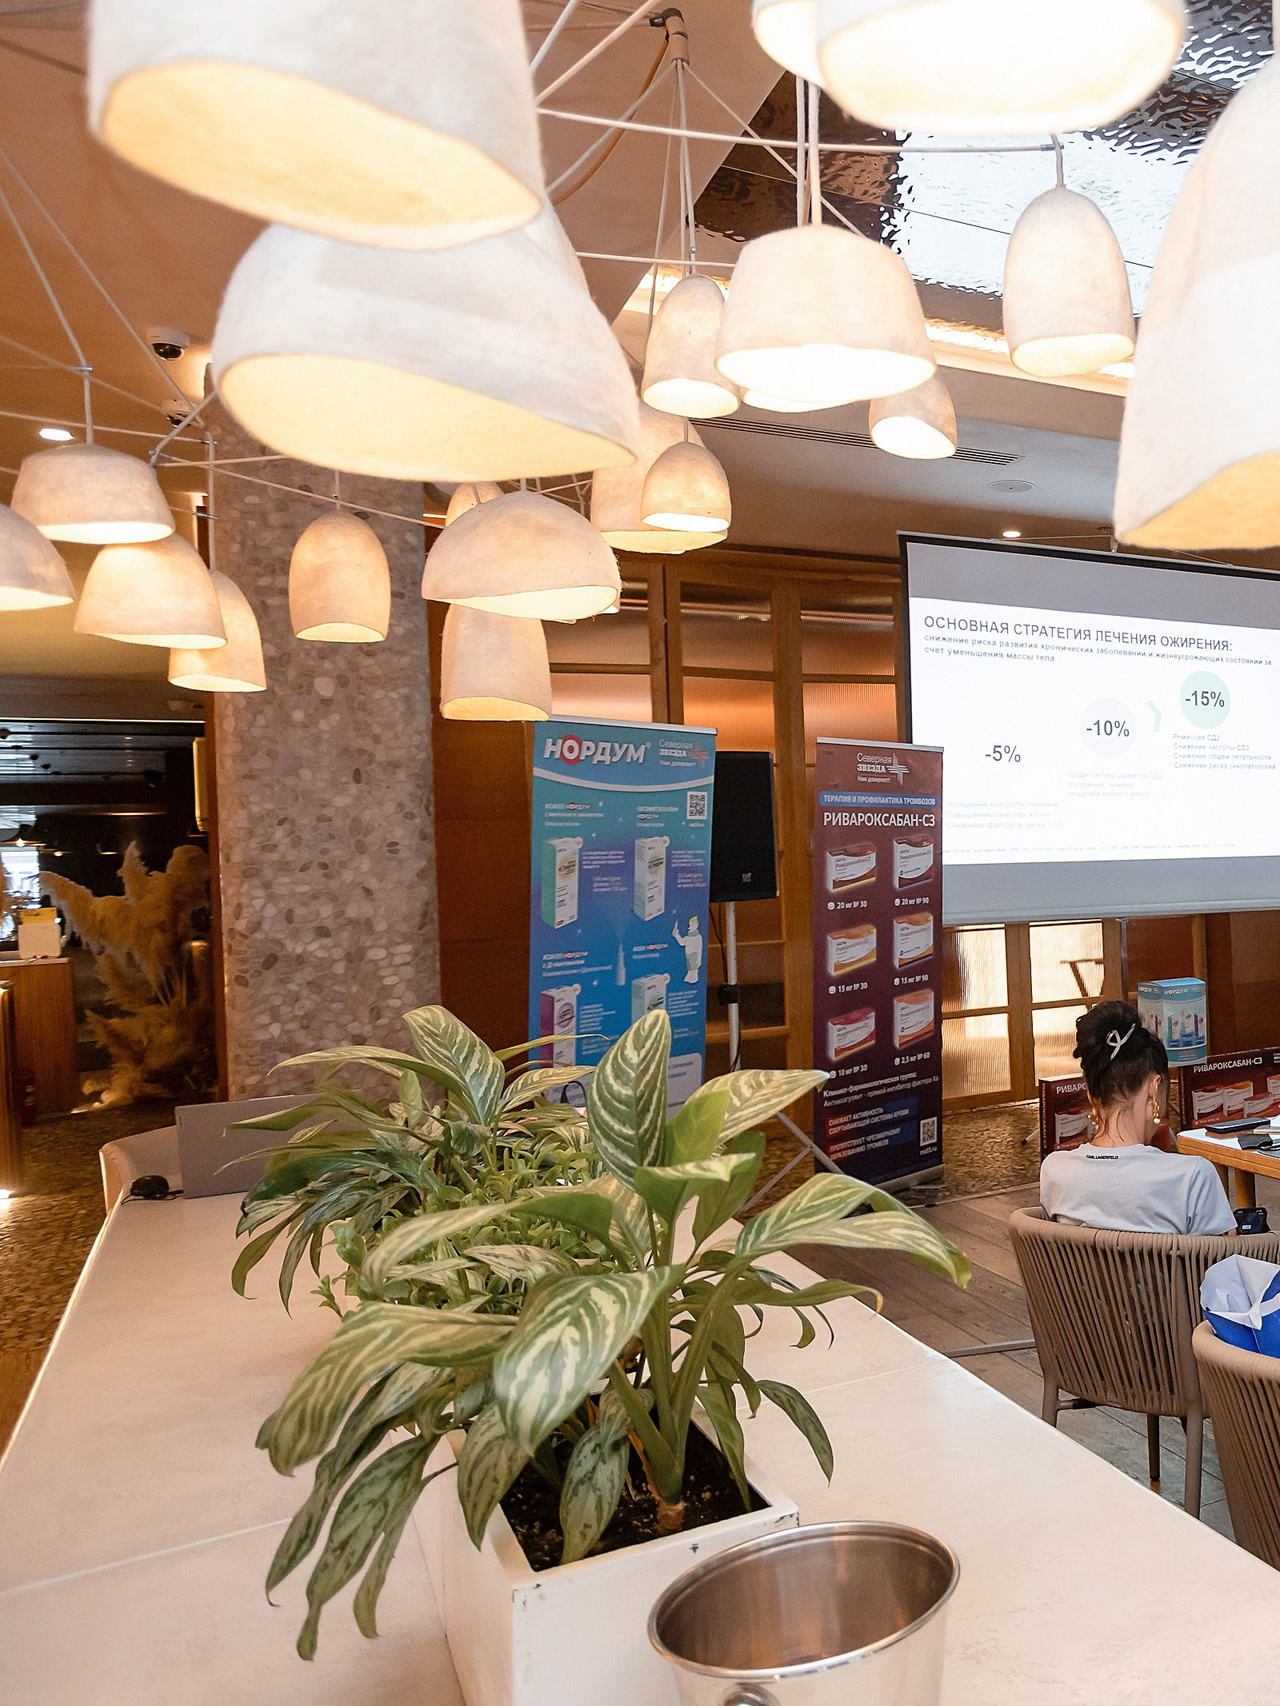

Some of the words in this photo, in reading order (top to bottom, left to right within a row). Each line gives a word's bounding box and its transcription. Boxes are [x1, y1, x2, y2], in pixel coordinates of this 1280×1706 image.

[924, 616, 1009, 634] ОСНОВНАЯ
[1013, 624, 1091, 641] СТРАТЕГИЯ
[1095, 630, 1156, 646] ЛЕЧЕНИЯ
[1160, 636, 1233, 652] ОЖИРЕНИЯ:
[924, 634, 969, 645] снижение
[971, 639, 997, 648] риска
[999, 641, 1038, 650] развития
[1041, 644, 1093, 654] хронических
[1096, 648, 1146, 657] заболеваний
[1155, 653, 1224, 662] жизнеугрожающих
[1226, 656, 1262, 665] состояний
[924, 646, 943, 654] счет
[947, 649, 1003, 659] уменьшения
[1006, 653, 1033, 661] массы
[1185, 690, 1225, 707] -15%
[1086, 720, 1130, 737] -10%
[857, 753, 893, 764] Северная
[985, 745, 1021, 762] -5%
[857, 764, 887, 773] ЗВЕЗДА
[857, 796, 903, 804] ПРОФИЛАКТИКА
[824, 812, 936, 827] РИВАРОКСАБАН-СЗ
[1193, 1057, 1263, 1073] РИВАРОКСАБАН-СЗ
[829, 1115, 852, 1126] СНИЖАЕТ
[852, 1108, 884, 1120] АКТИВНОСТЬ
[870, 1113, 894, 1124] СИСТЕМЫ
[894, 1109, 910, 1118] КРОВИ
